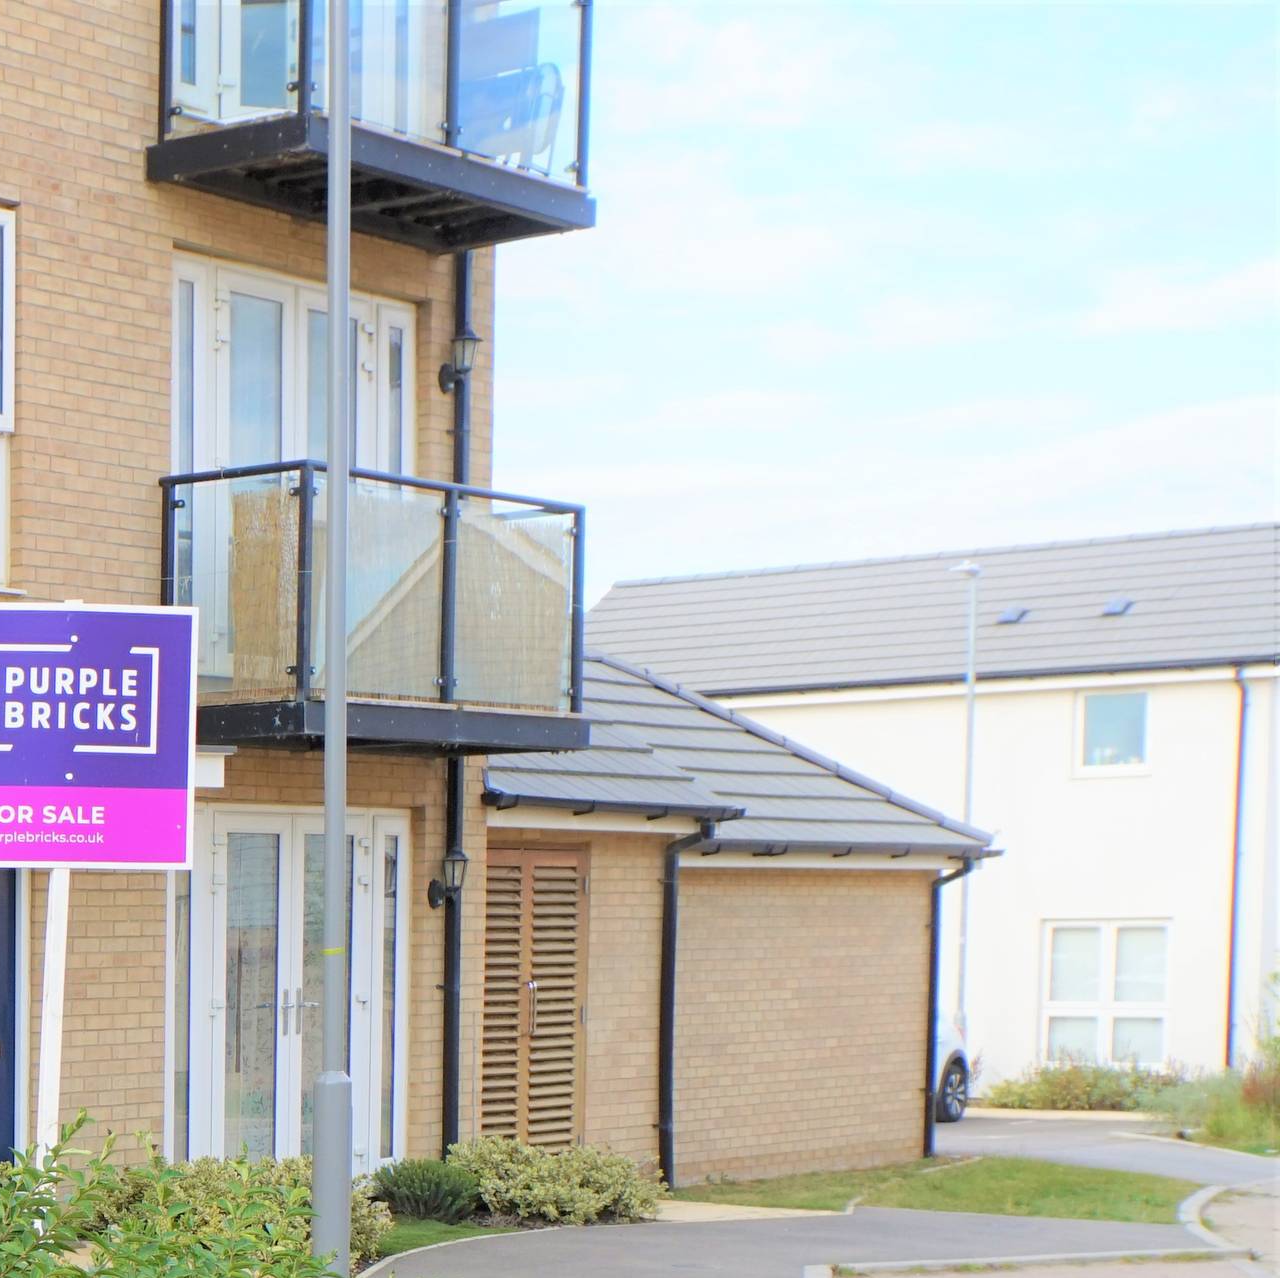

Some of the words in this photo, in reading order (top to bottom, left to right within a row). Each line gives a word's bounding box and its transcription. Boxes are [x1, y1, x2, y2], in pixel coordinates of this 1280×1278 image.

[5, 666, 138, 697] PURPLE
[4, 701, 137, 731] BRICKS
[42, 805, 105, 825] SALE
